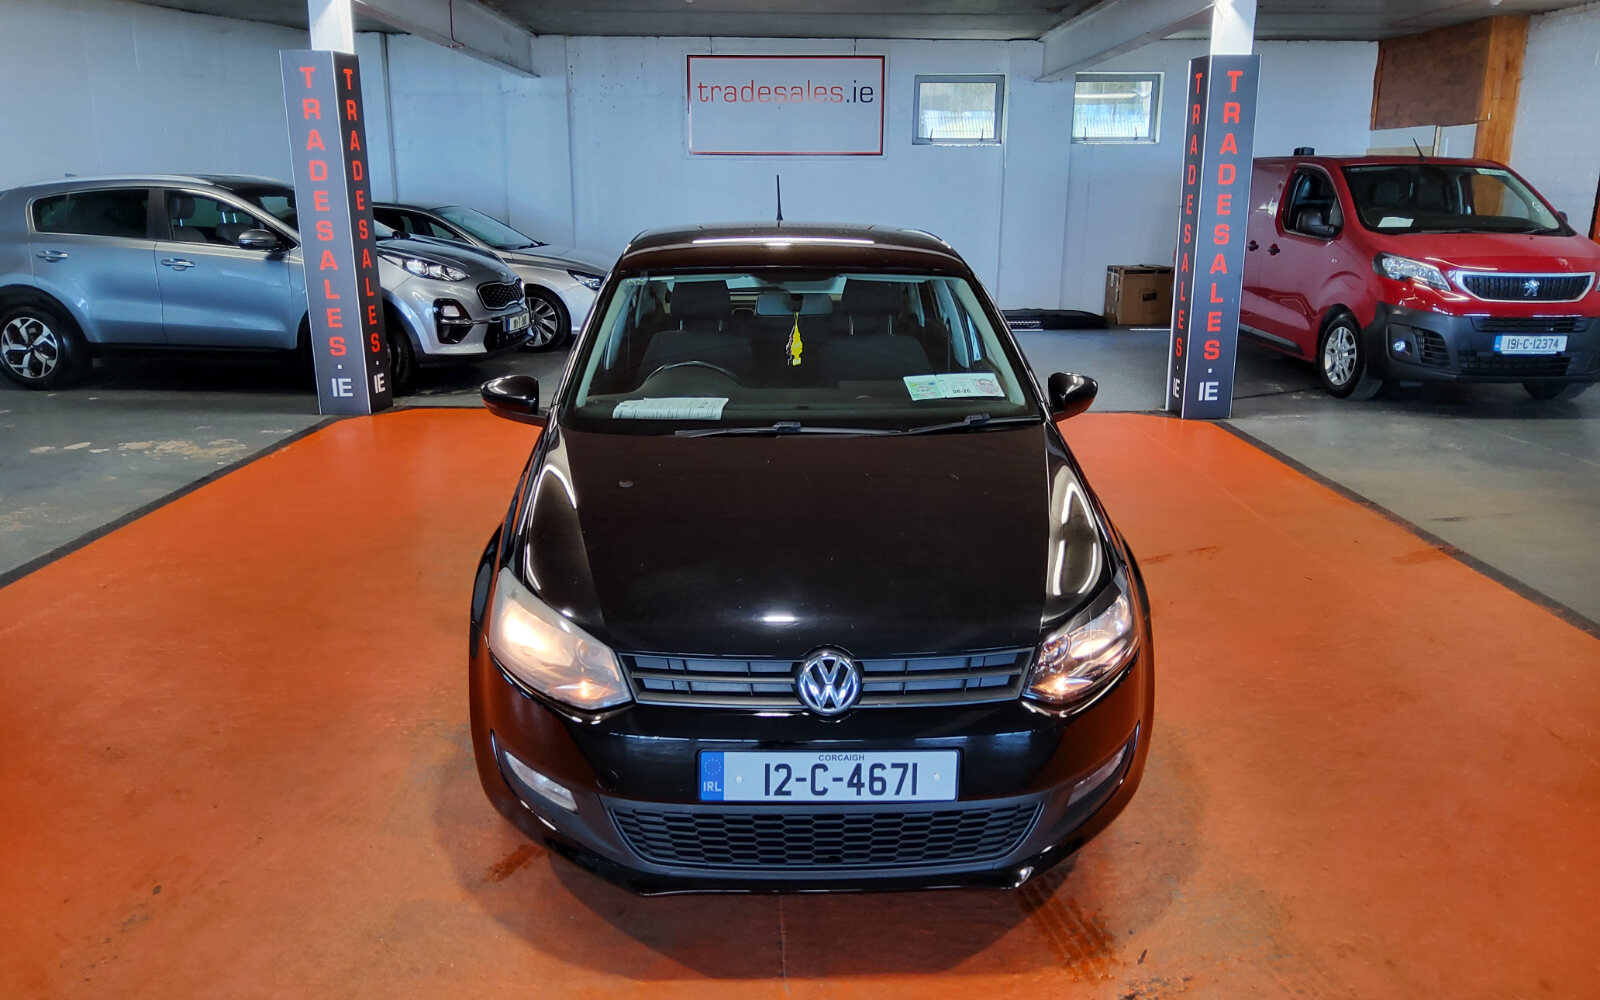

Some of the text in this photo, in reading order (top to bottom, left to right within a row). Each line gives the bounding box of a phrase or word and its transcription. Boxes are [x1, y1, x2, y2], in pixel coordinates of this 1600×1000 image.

[697, 79, 874, 103] tradesales.ie
[1506, 338, 1559, 350] 191-C-12374
[818, 754, 865, 762] CORCAIGH
[764, 762, 918, 796] 12-C-4671
[703, 781, 722, 792] IRL
